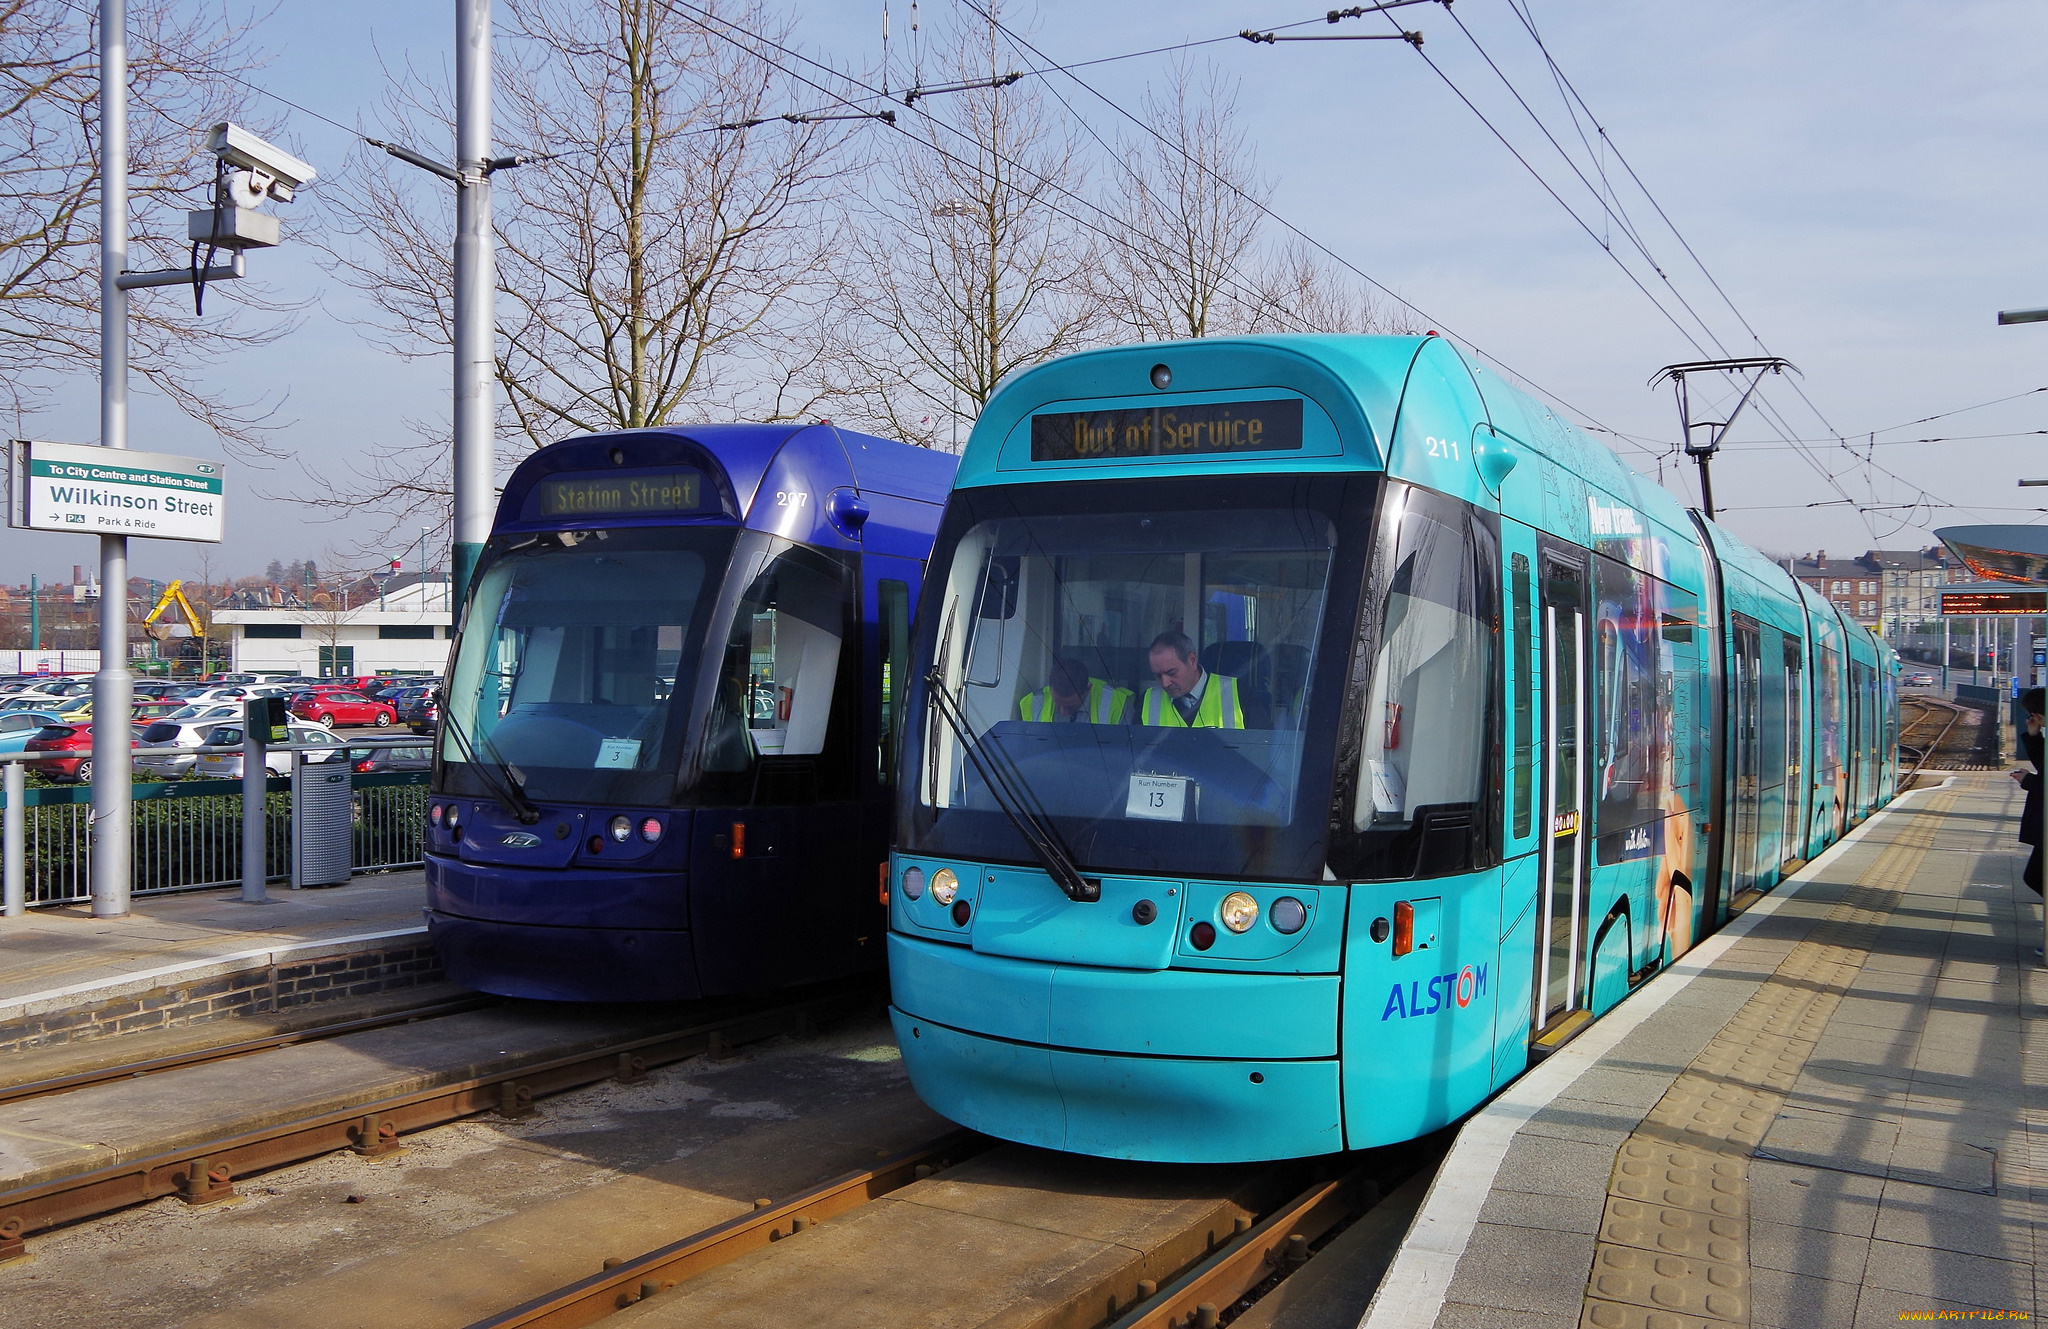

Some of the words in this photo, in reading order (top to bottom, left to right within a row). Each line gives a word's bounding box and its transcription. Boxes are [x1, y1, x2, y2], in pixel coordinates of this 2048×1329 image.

[1073, 417, 1115, 454] Out
[1125, 412, 1152, 451] of
[1161, 410, 1263, 450] Service
[1425, 436, 1459, 461] 211
[49, 464, 64, 475] To
[66, 466, 89, 478] City
[91, 468, 127, 481] Centre
[128, 473, 148, 483] and
[149, 474, 183, 487] Station
[183, 478, 209, 490] Street
[50, 485, 158, 511] Wilkinson
[165, 496, 214, 516] Street
[557, 483, 621, 511] Station
[629, 478, 691, 508] Street
[775, 491, 809, 508] 207
[98, 516, 122, 526] Park
[124, 518, 133, 527] &
[134, 519, 156, 528] Ride
[612, 751, 621, 761] 3
[1152, 780, 1178, 788] Number
[1149, 792, 1164, 808] 13
[1381, 962, 1488, 1021] ALSTOM
